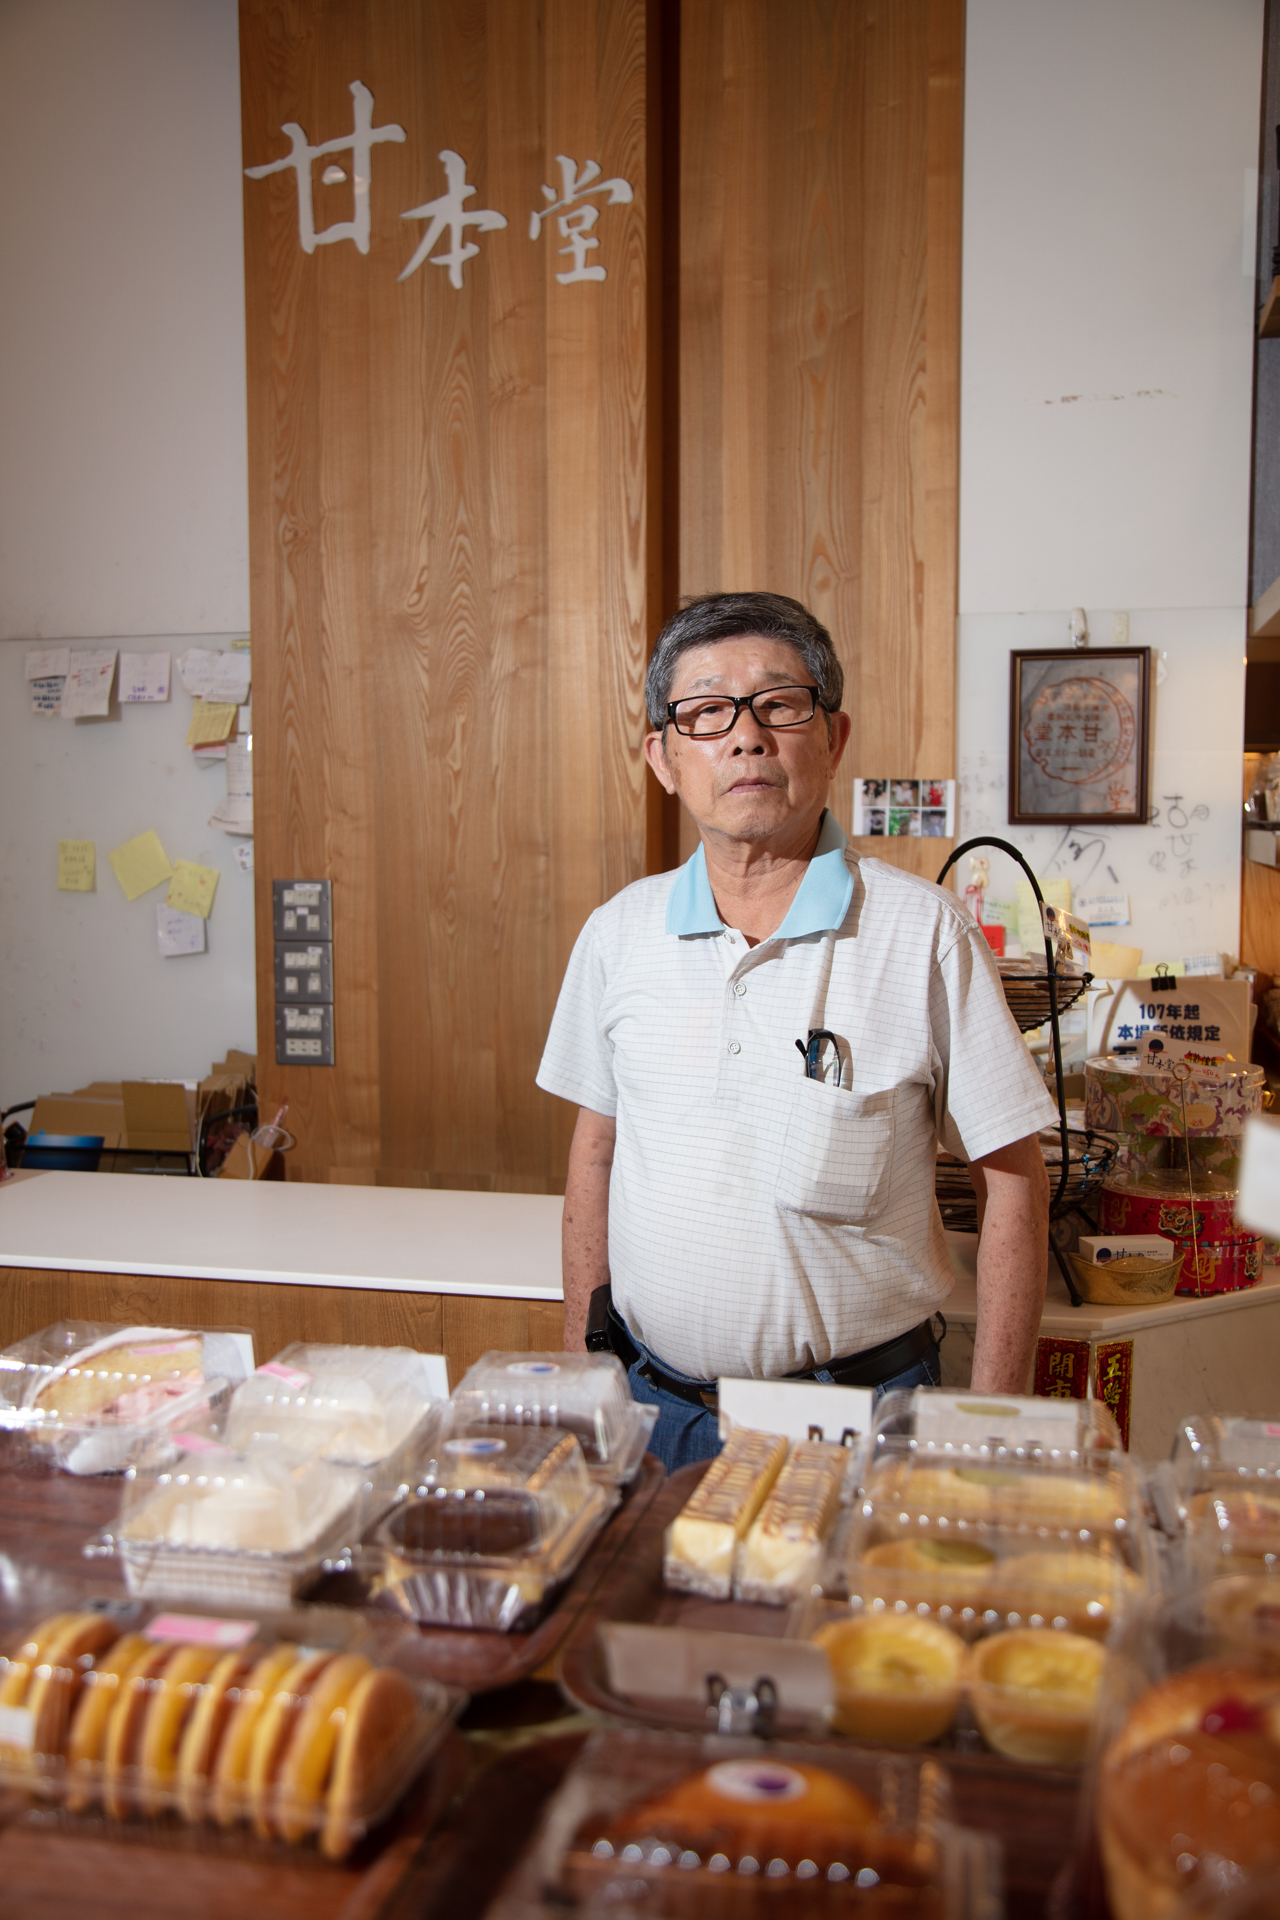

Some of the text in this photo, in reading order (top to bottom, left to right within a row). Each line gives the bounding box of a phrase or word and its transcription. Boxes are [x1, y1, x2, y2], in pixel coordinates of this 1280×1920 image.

[244, 80, 634, 290] 甘本堂
[1034, 722, 1102, 744] 甘本堂
[1139, 1003, 1200, 1020] 107年起
[1144, 1052, 1175, 1071] 甘本堂
